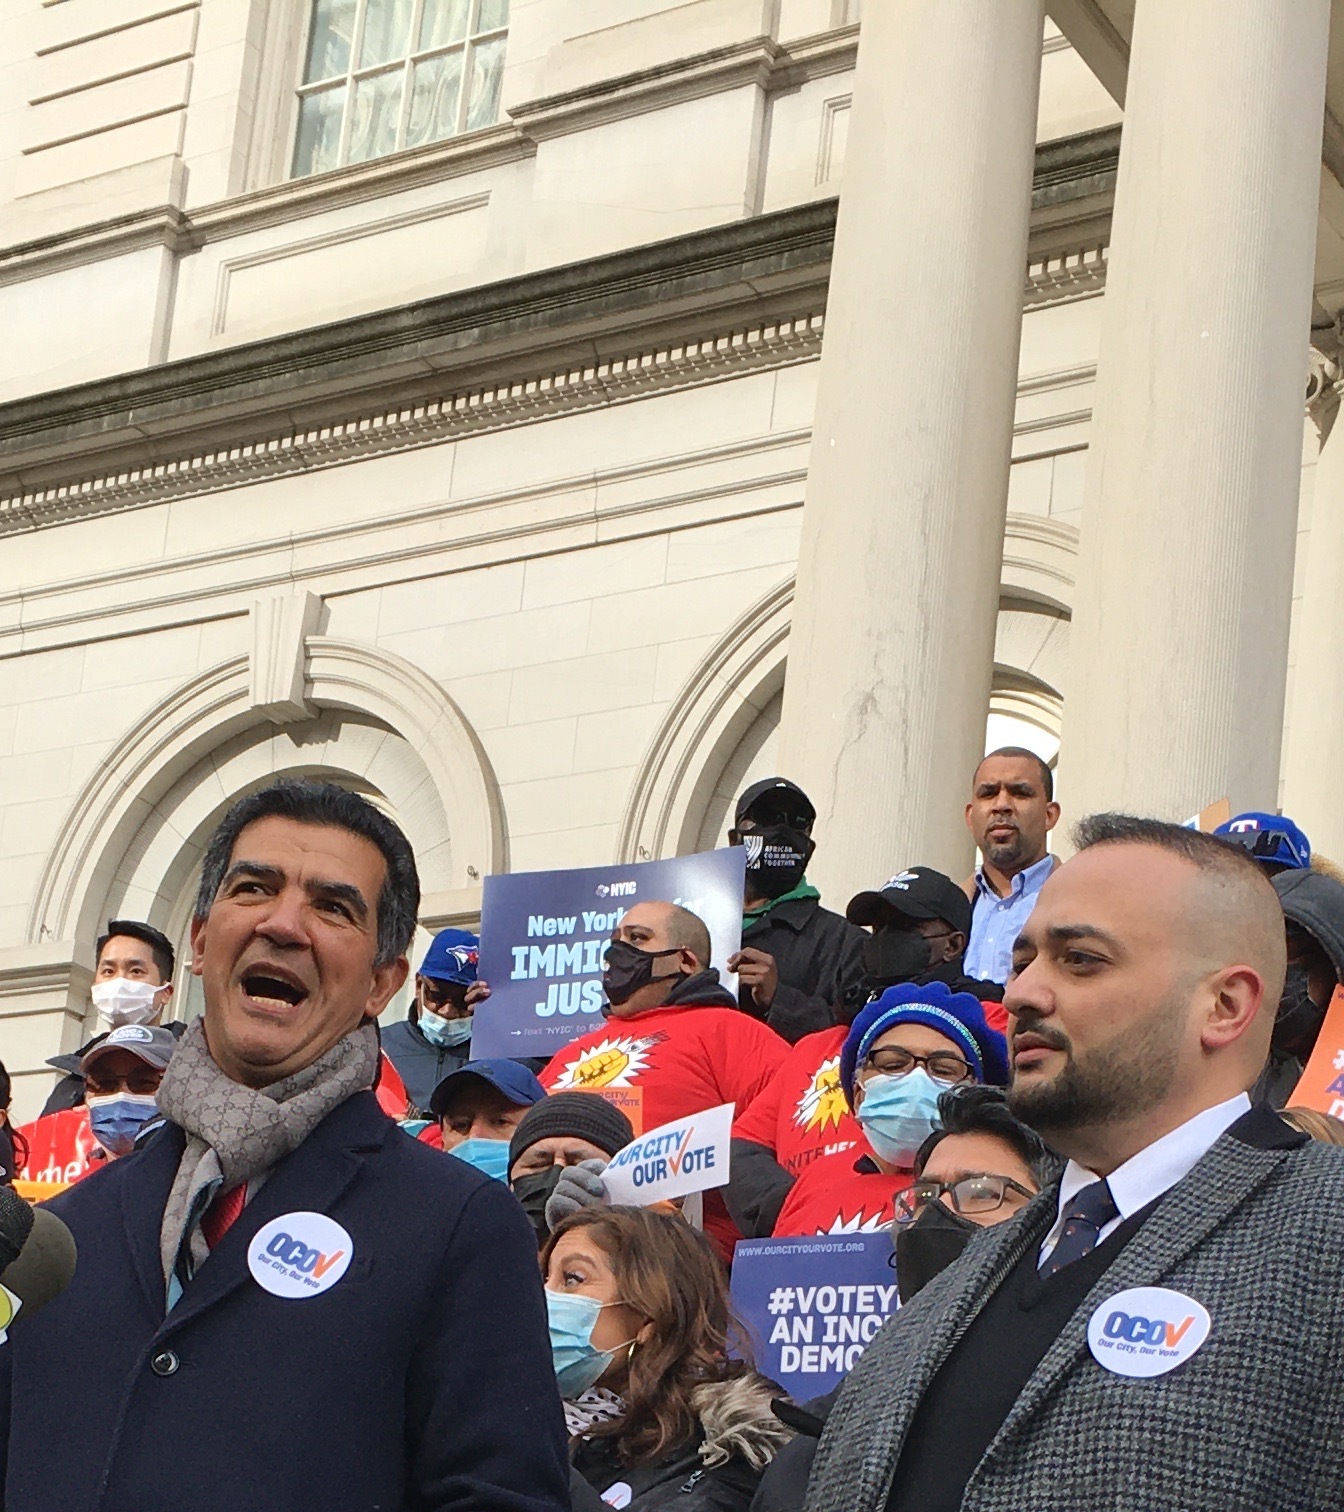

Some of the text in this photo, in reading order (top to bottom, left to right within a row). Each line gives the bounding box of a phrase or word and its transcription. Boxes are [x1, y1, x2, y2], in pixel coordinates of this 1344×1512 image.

[610, 881, 637, 897] NYIC
[527, 915, 578, 938] New
[535, 979, 601, 1018] JUS
[643, 1129, 686, 1160] CITY
[632, 1145, 716, 1187] OUR VOTE
[266, 1232, 345, 1279] OCOV
[738, 1242, 865, 1257] WWW.OURCITYOURVOTE.ORG
[258, 1253, 272, 1265] Our
[289, 1270, 304, 1281] Our
[303, 1276, 320, 1289] Vote
[767, 1284, 901, 1314] #VOTEY
[769, 1314, 888, 1344] AN INC
[1103, 1310, 1197, 1348] OCOV
[779, 1344, 862, 1373] DEMO
[1097, 1338, 1114, 1348] Our
[1139, 1347, 1157, 1355] Our
[1159, 1348, 1180, 1357] Vote
